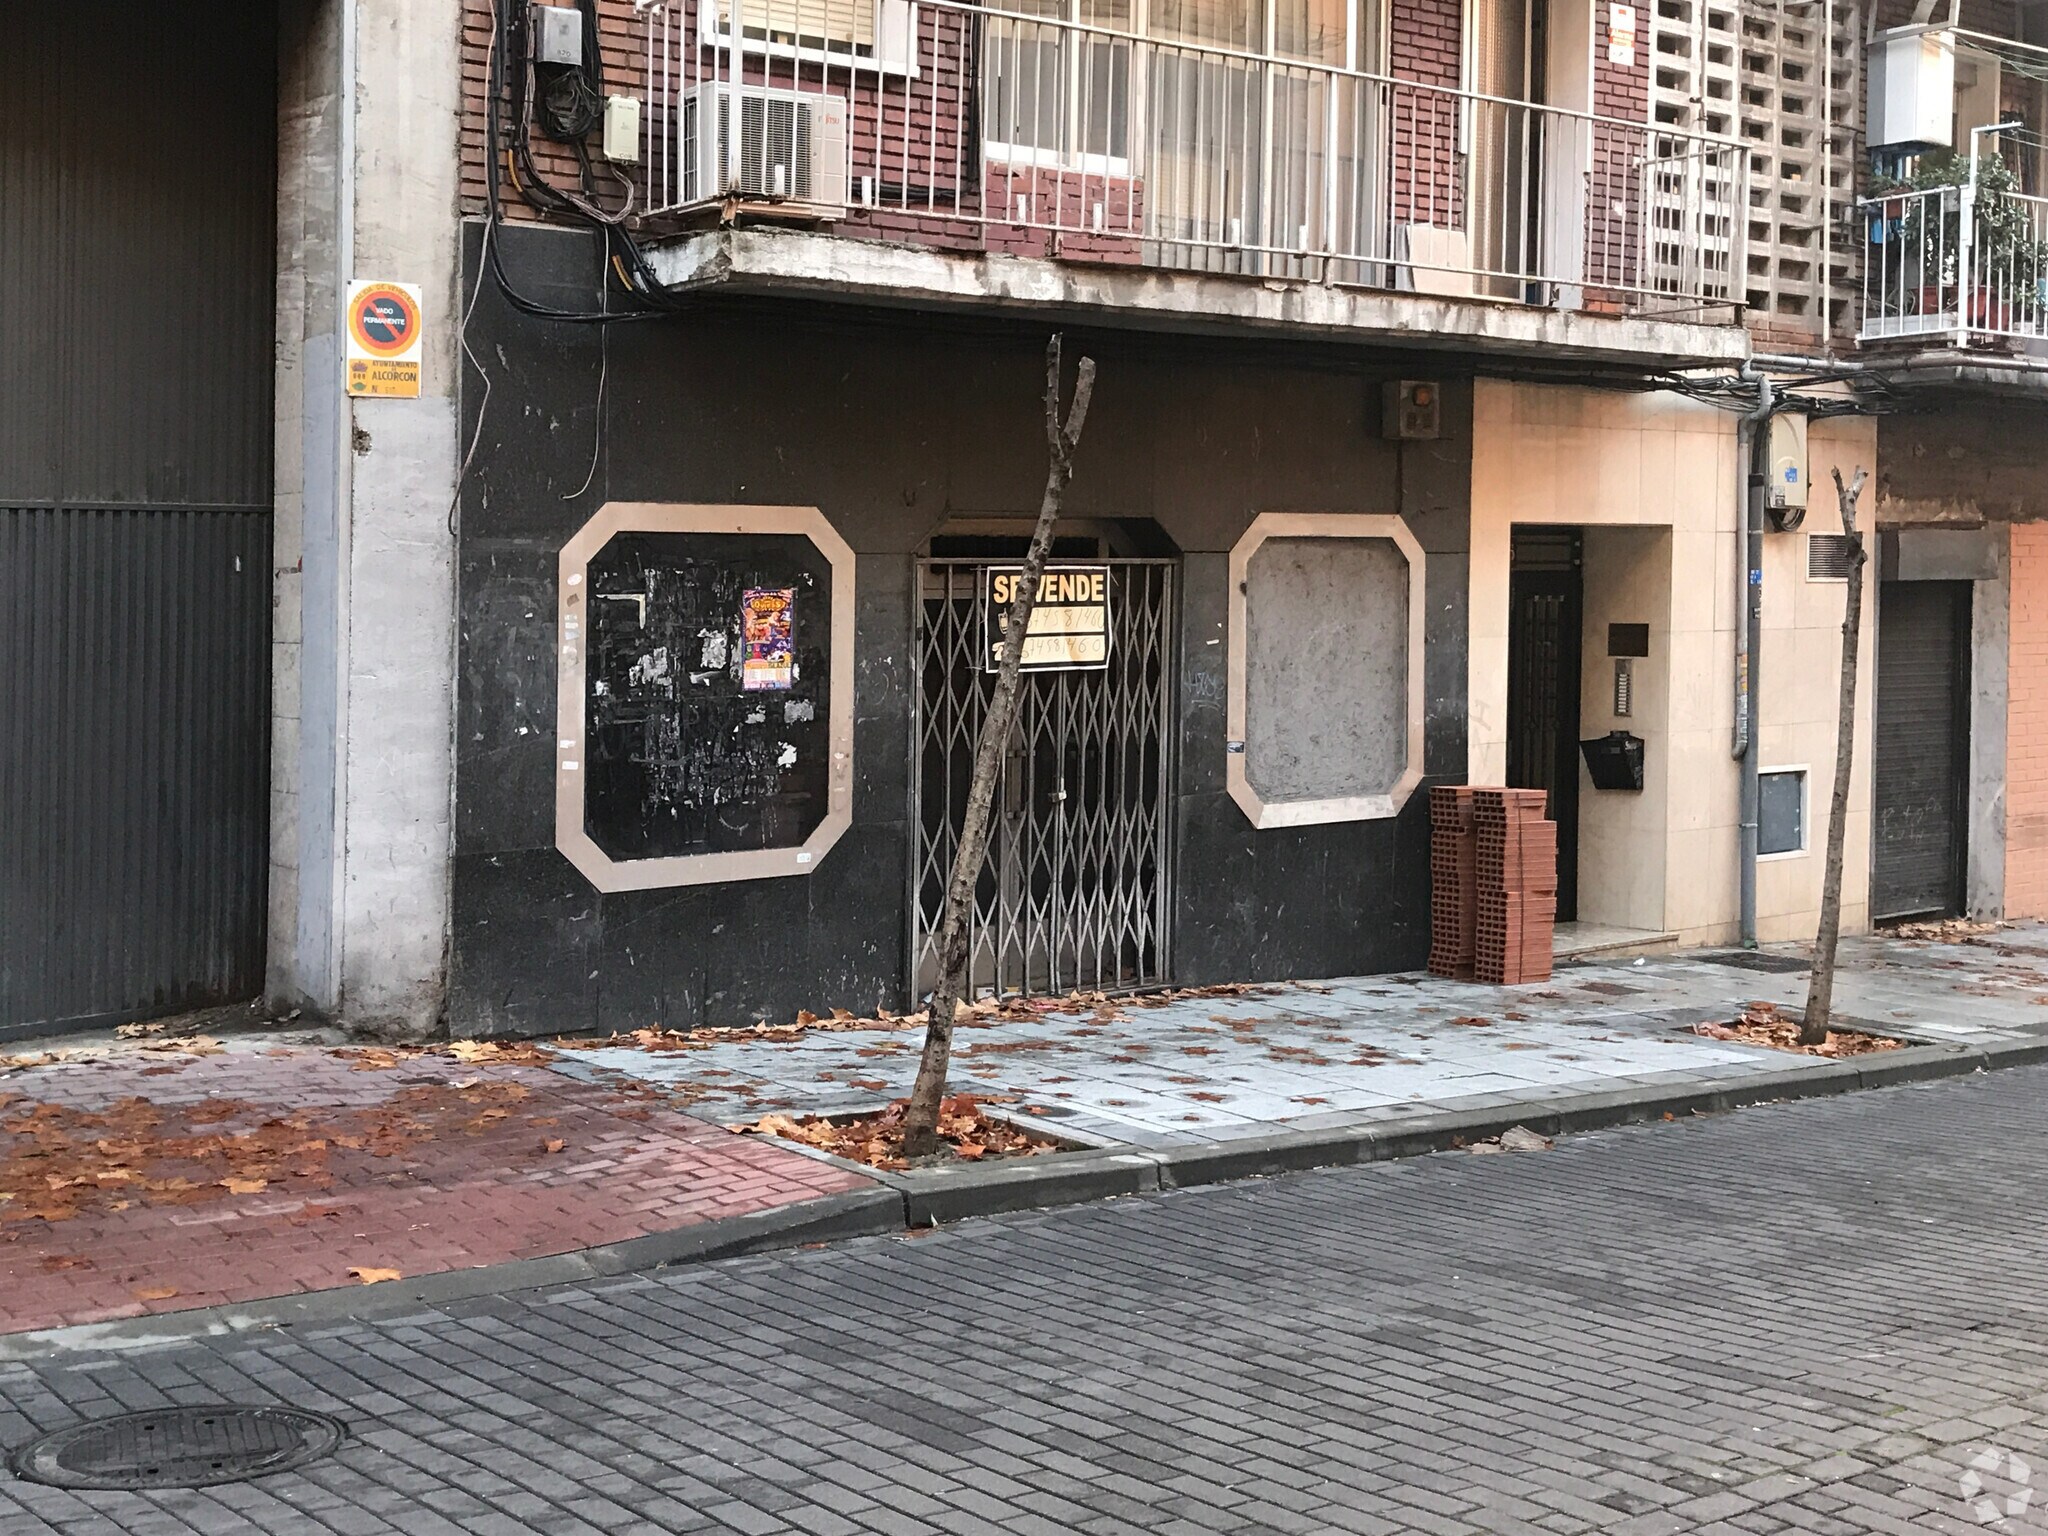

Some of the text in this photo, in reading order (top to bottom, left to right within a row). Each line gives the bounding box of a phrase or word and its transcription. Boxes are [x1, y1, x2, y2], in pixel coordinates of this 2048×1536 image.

[375, 307, 394, 315] VADO
[363, 316, 406, 326] PERMANENTE
[372, 360, 418, 369] AYUNTAMIENTO
[1035, 574, 1105, 603] VENDE
